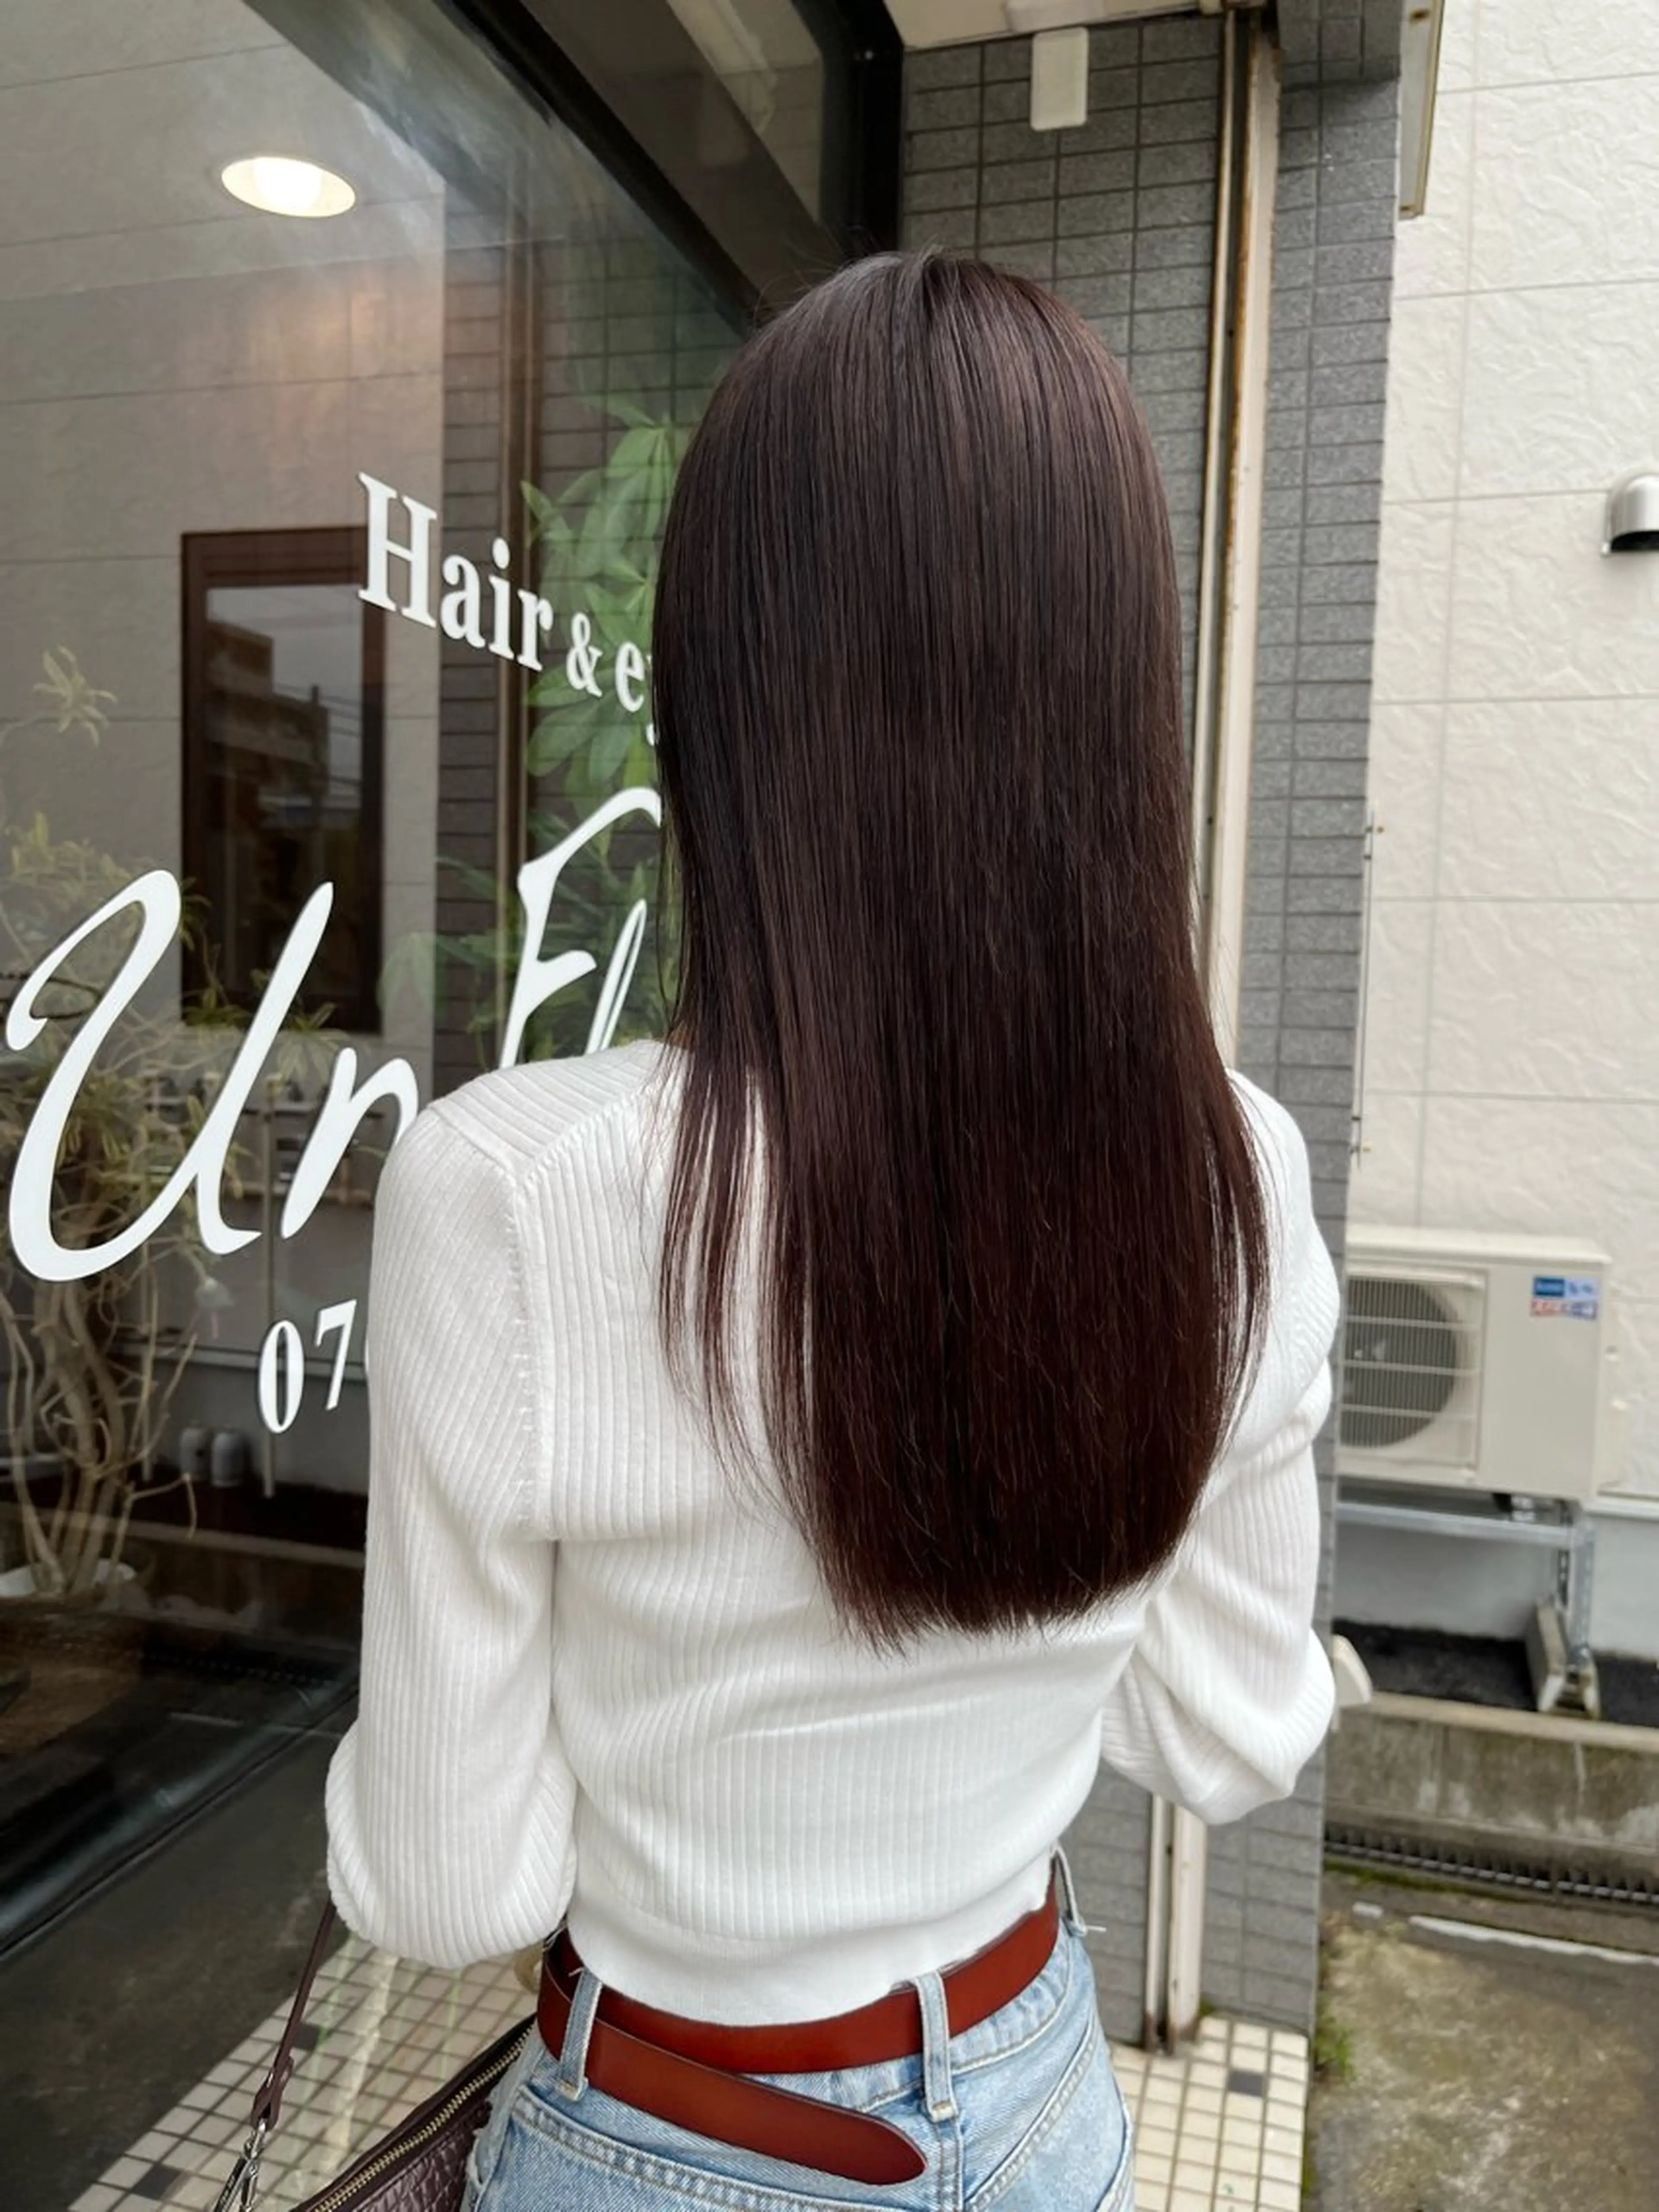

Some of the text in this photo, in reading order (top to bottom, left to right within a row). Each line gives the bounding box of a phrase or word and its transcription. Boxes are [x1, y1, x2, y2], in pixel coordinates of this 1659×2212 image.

[358, 471, 655, 747] Hair & e
